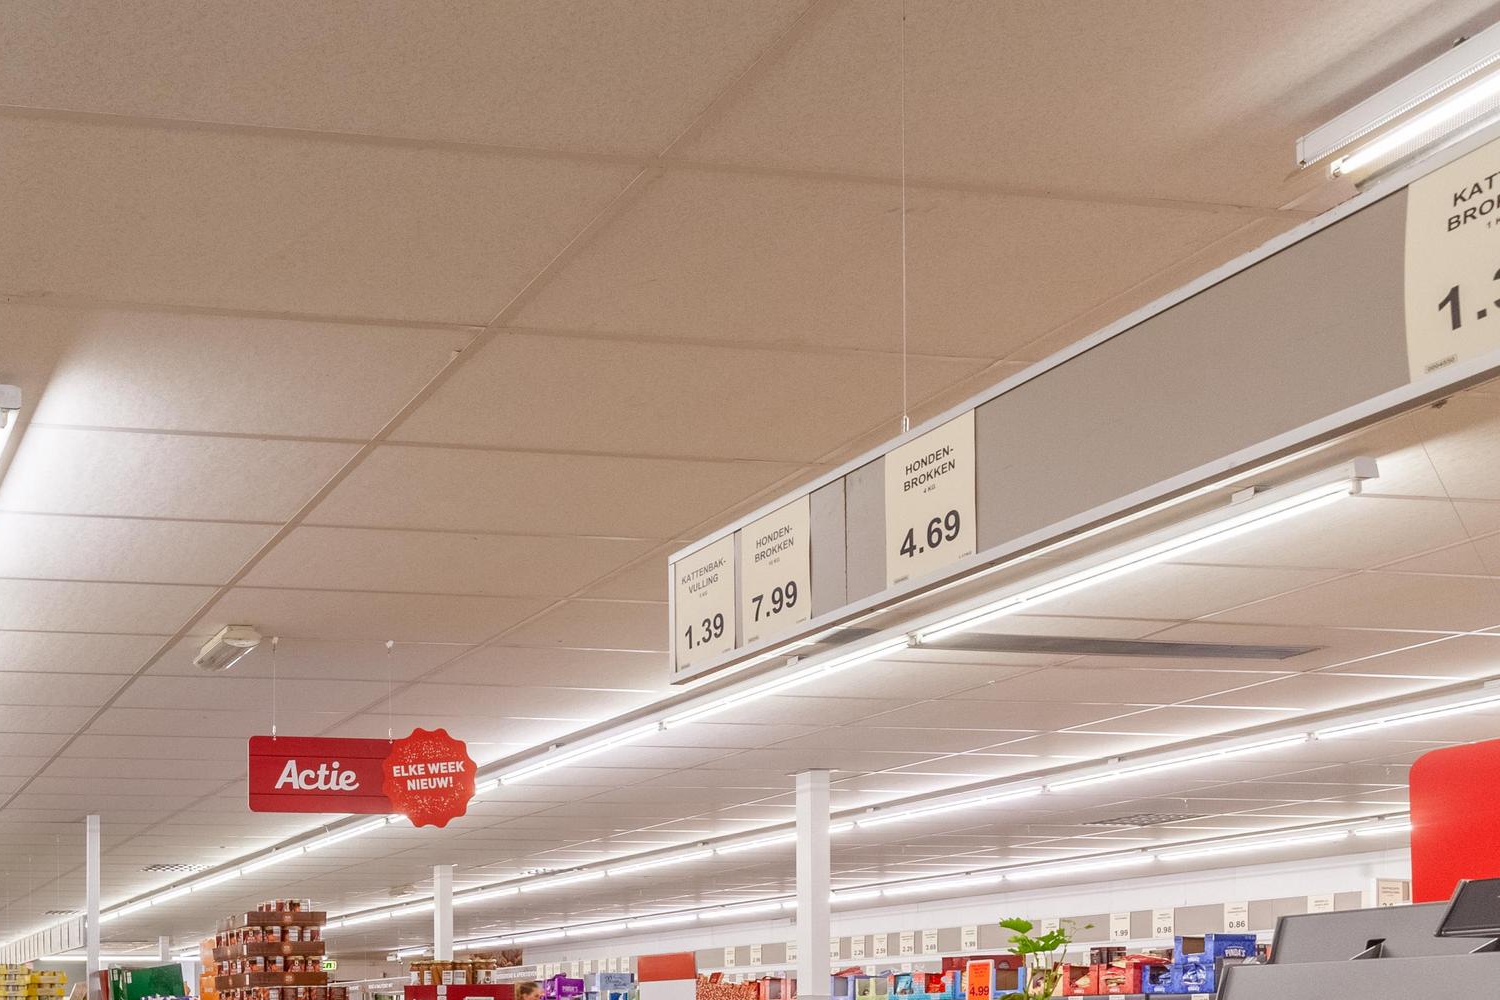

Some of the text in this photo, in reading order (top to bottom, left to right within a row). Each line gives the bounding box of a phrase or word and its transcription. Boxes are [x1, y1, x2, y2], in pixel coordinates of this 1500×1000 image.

[1453, 171, 1500, 207] KAT
[1447, 194, 1500, 232] BRO
[905, 445, 954, 476] HONDEN-
[903, 459, 956, 492] BROKKEN
[755, 525, 793, 549] HONDEN-
[900, 510, 961, 558] 4.69
[754, 537, 795, 563] BROKKEN
[681, 557, 727, 585] KATTENBAK-
[688, 573, 719, 594] VULLING
[751, 580, 798, 622] 7.99
[685, 613, 724, 650] 1.39
[274, 759, 360, 791] Actie
[392, 761, 465, 777] ELKE WEEK
[406, 776, 454, 791] NIEUW!
[1114, 929, 1129, 937] 1.99
[1156, 926, 1172, 934] 0.98
[1229, 920, 1246, 929] 0.86
[1225, 949, 1246, 957] PINDA'S
[969, 985, 990, 997] 4.99
